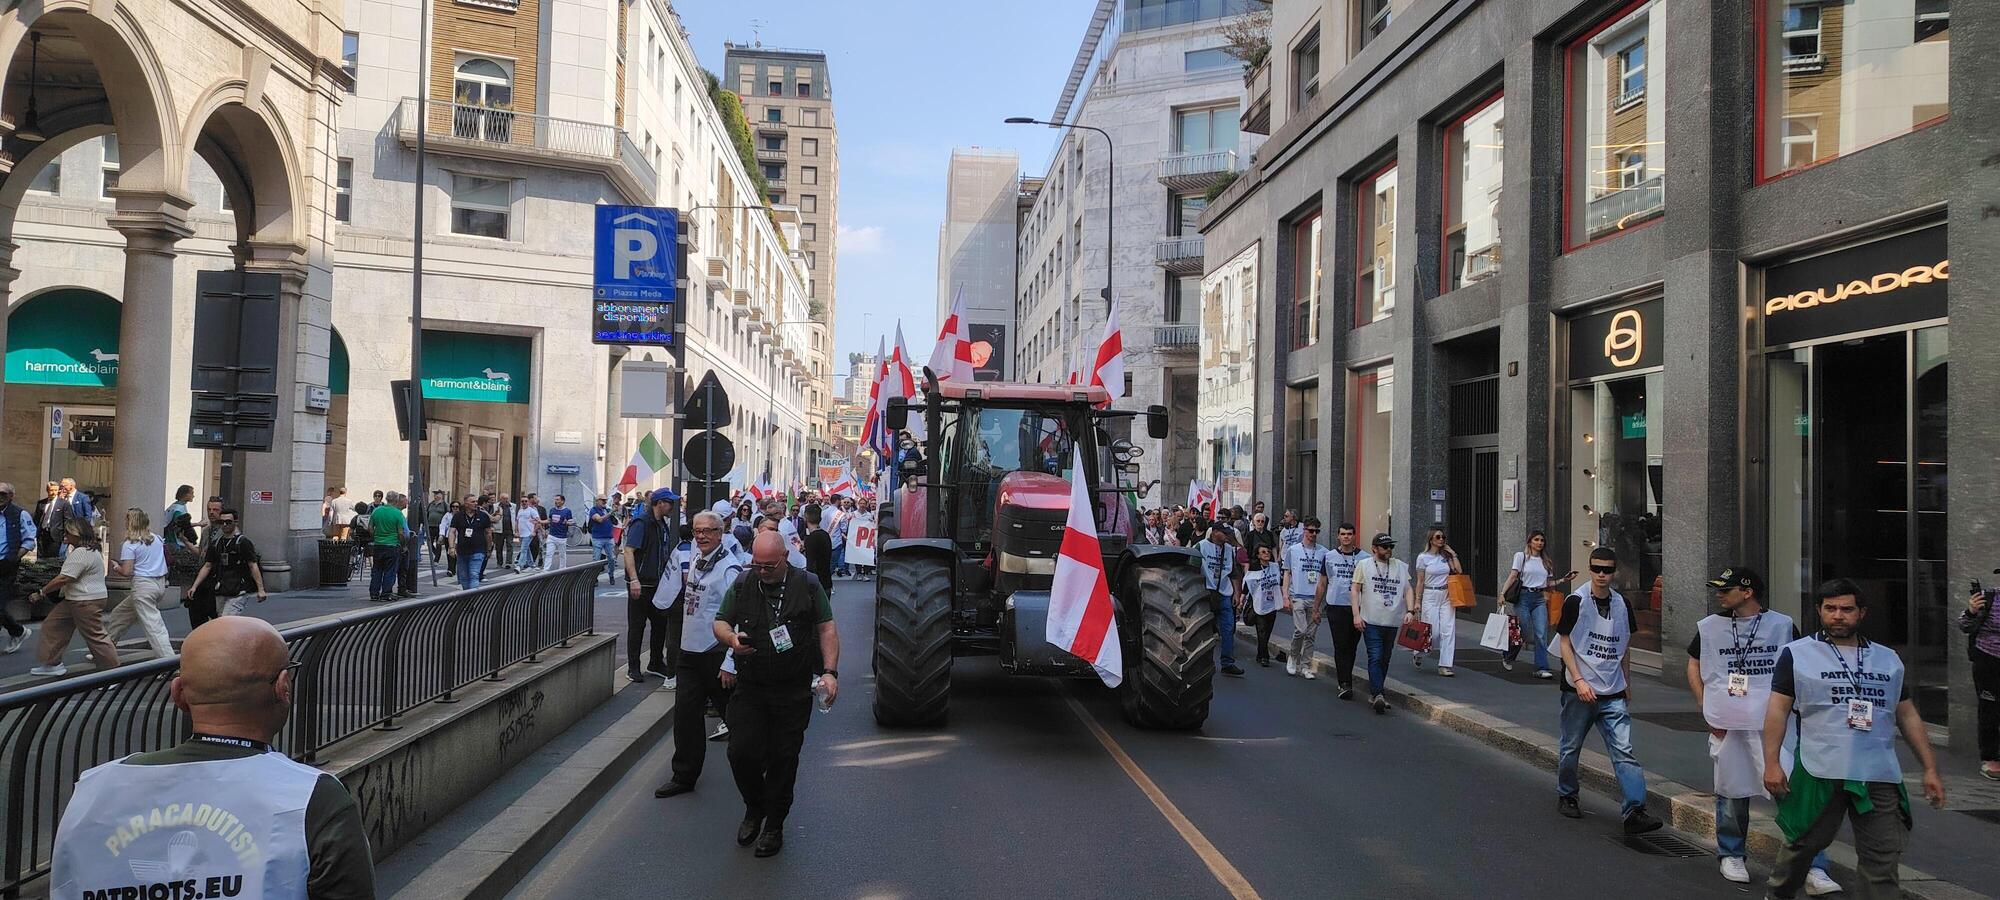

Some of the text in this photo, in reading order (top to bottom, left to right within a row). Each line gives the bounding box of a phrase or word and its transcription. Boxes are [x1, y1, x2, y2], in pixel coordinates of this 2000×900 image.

[613, 289, 662, 298] Piazza Meda
[597, 302, 669, 314] abbonamenti
[603, 312, 657, 323] disponibili
[25, 361, 119, 374] harmont&blain
[430, 378, 512, 391] harmont&blaine
[856, 526, 876, 549] PA
[1831, 686, 1885, 697] SERIZIO
